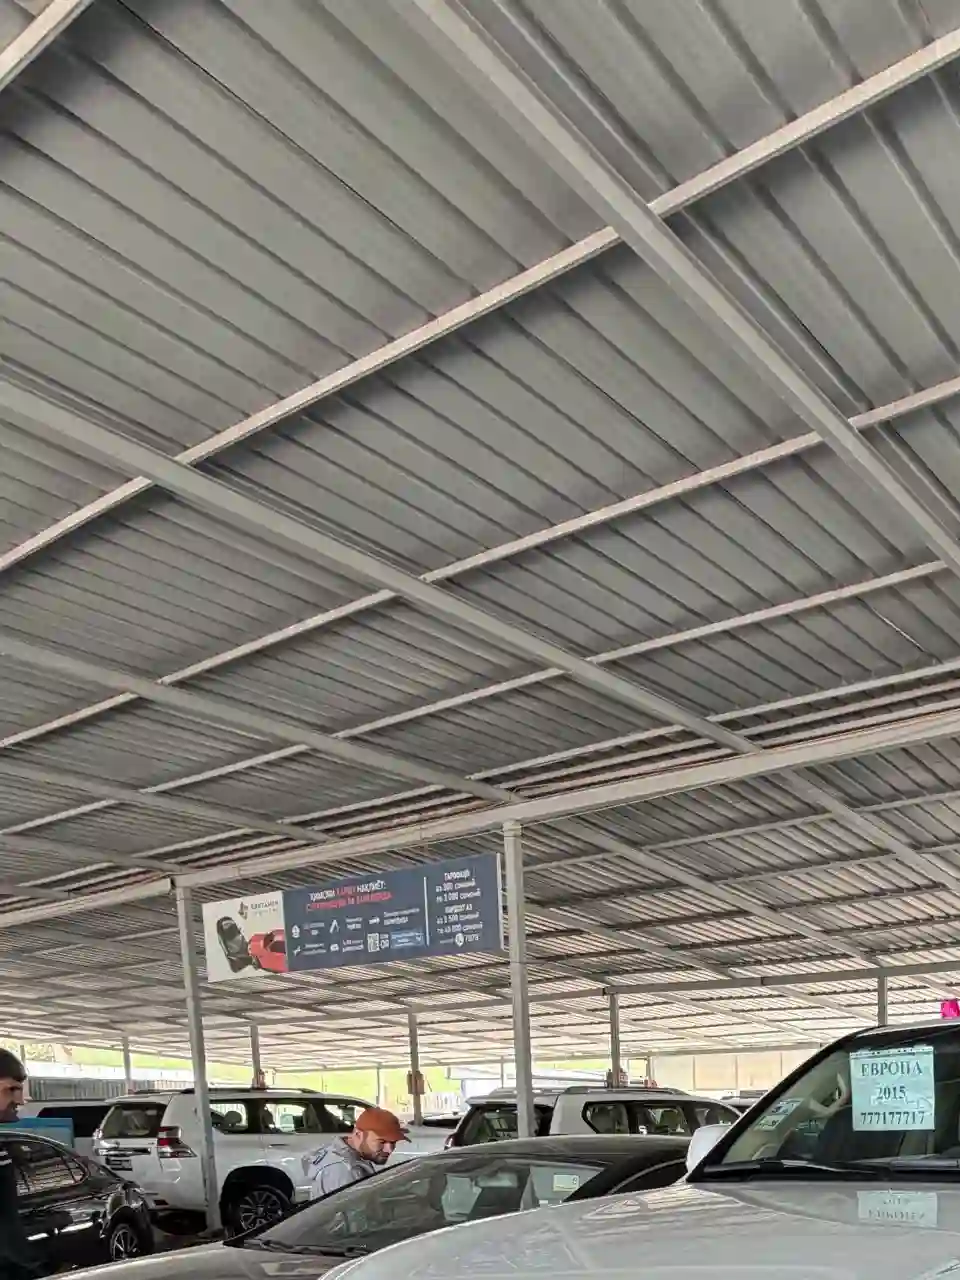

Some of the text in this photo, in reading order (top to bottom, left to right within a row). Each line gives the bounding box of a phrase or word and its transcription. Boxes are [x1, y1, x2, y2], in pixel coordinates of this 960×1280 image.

[861, 1060, 923, 1077] ЕВРОПА
[876, 1085, 907, 1101] 2015
[860, 1111, 926, 1125] 777177717
